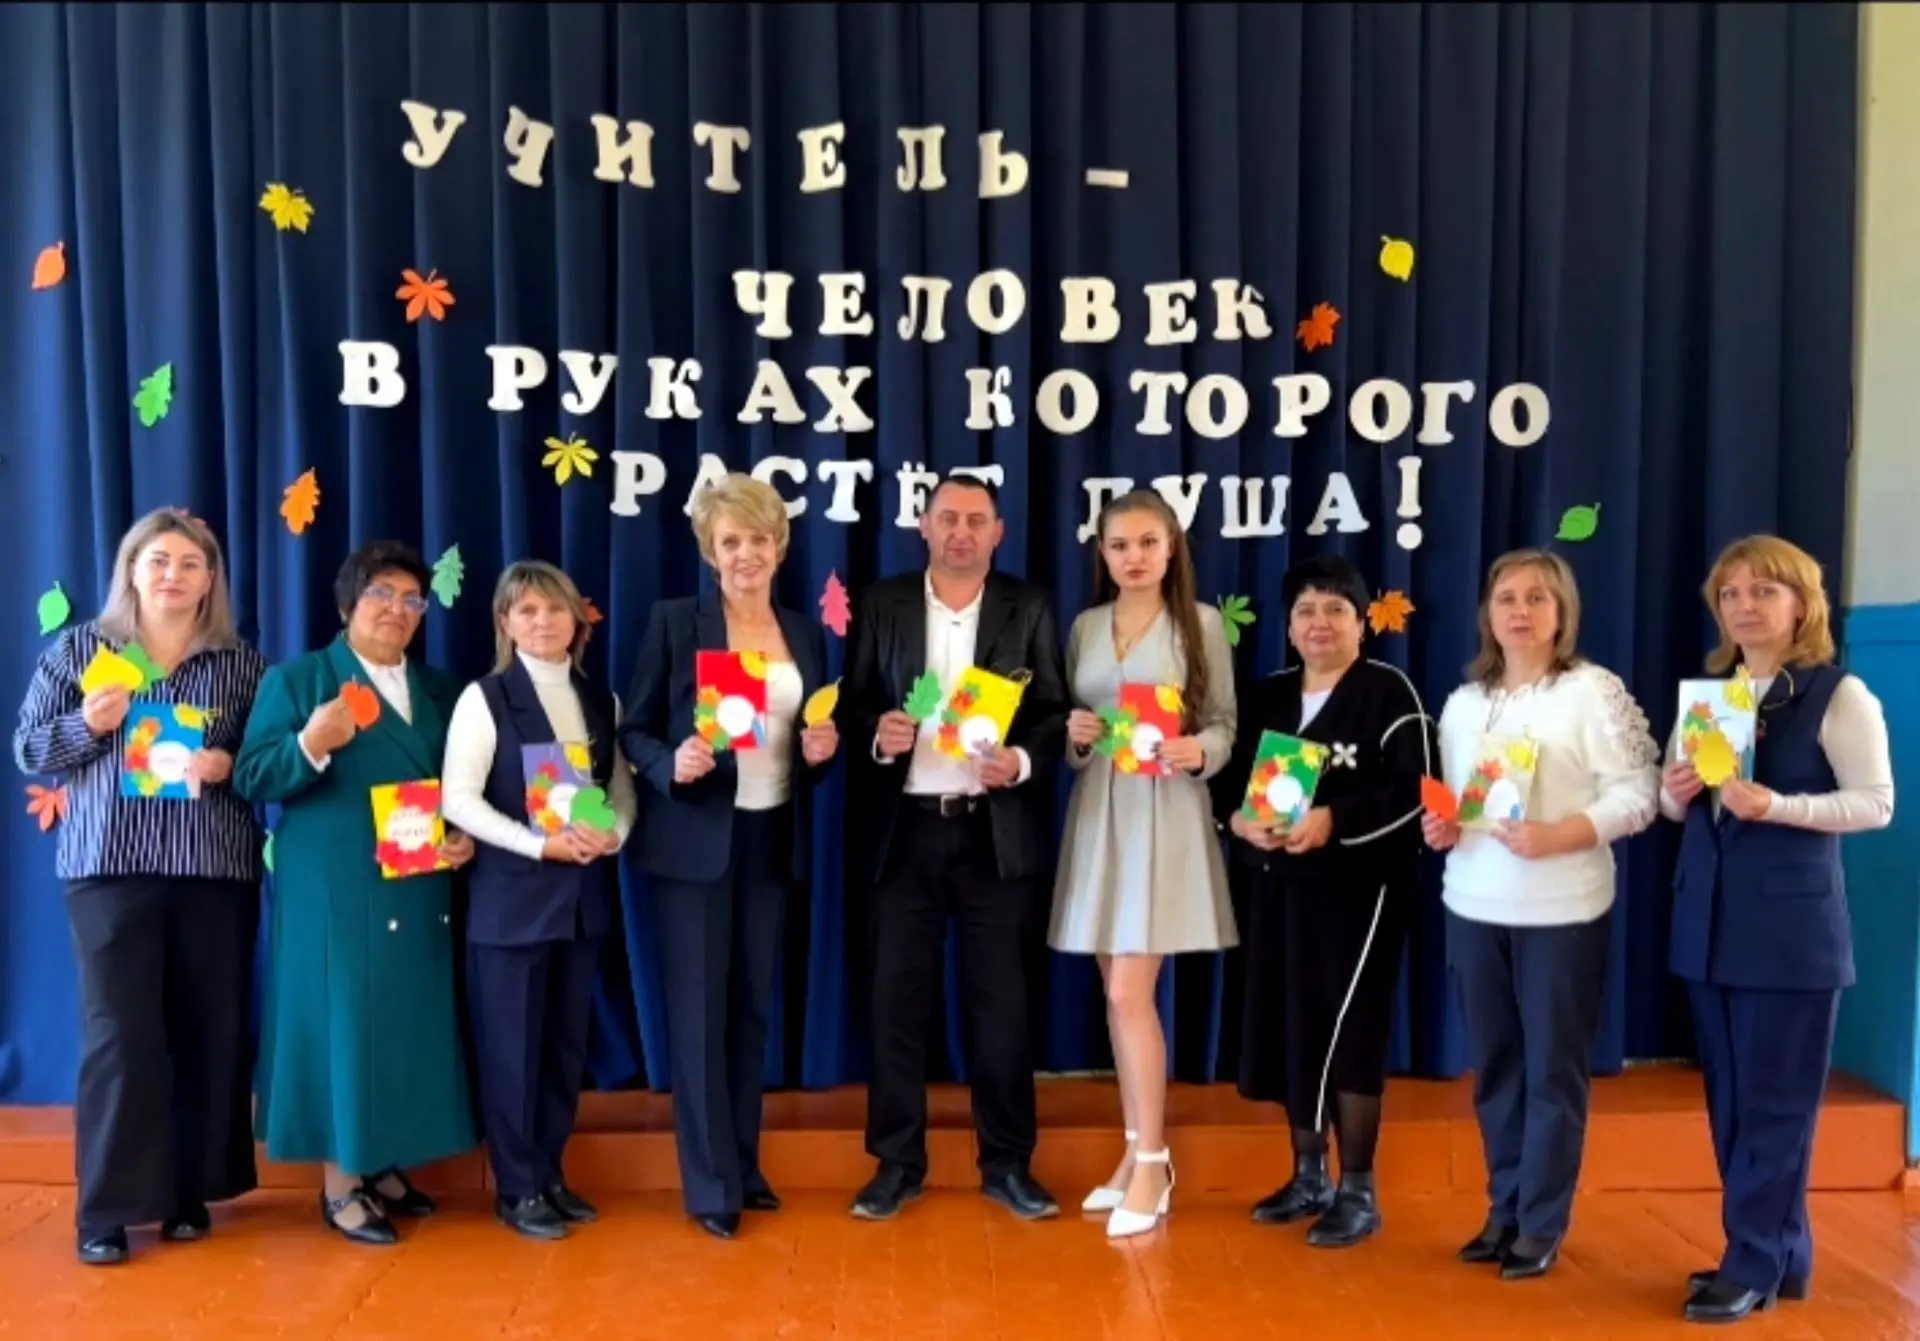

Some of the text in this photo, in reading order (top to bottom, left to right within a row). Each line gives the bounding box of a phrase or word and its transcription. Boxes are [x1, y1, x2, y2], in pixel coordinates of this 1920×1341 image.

[400, 100, 1029, 198] УЧИТЕЛЬ
[731, 267, 1273, 346] ЧЕЛОВЕК
[337, 338, 1550, 447] В РУКАХ КОТОРОГО
